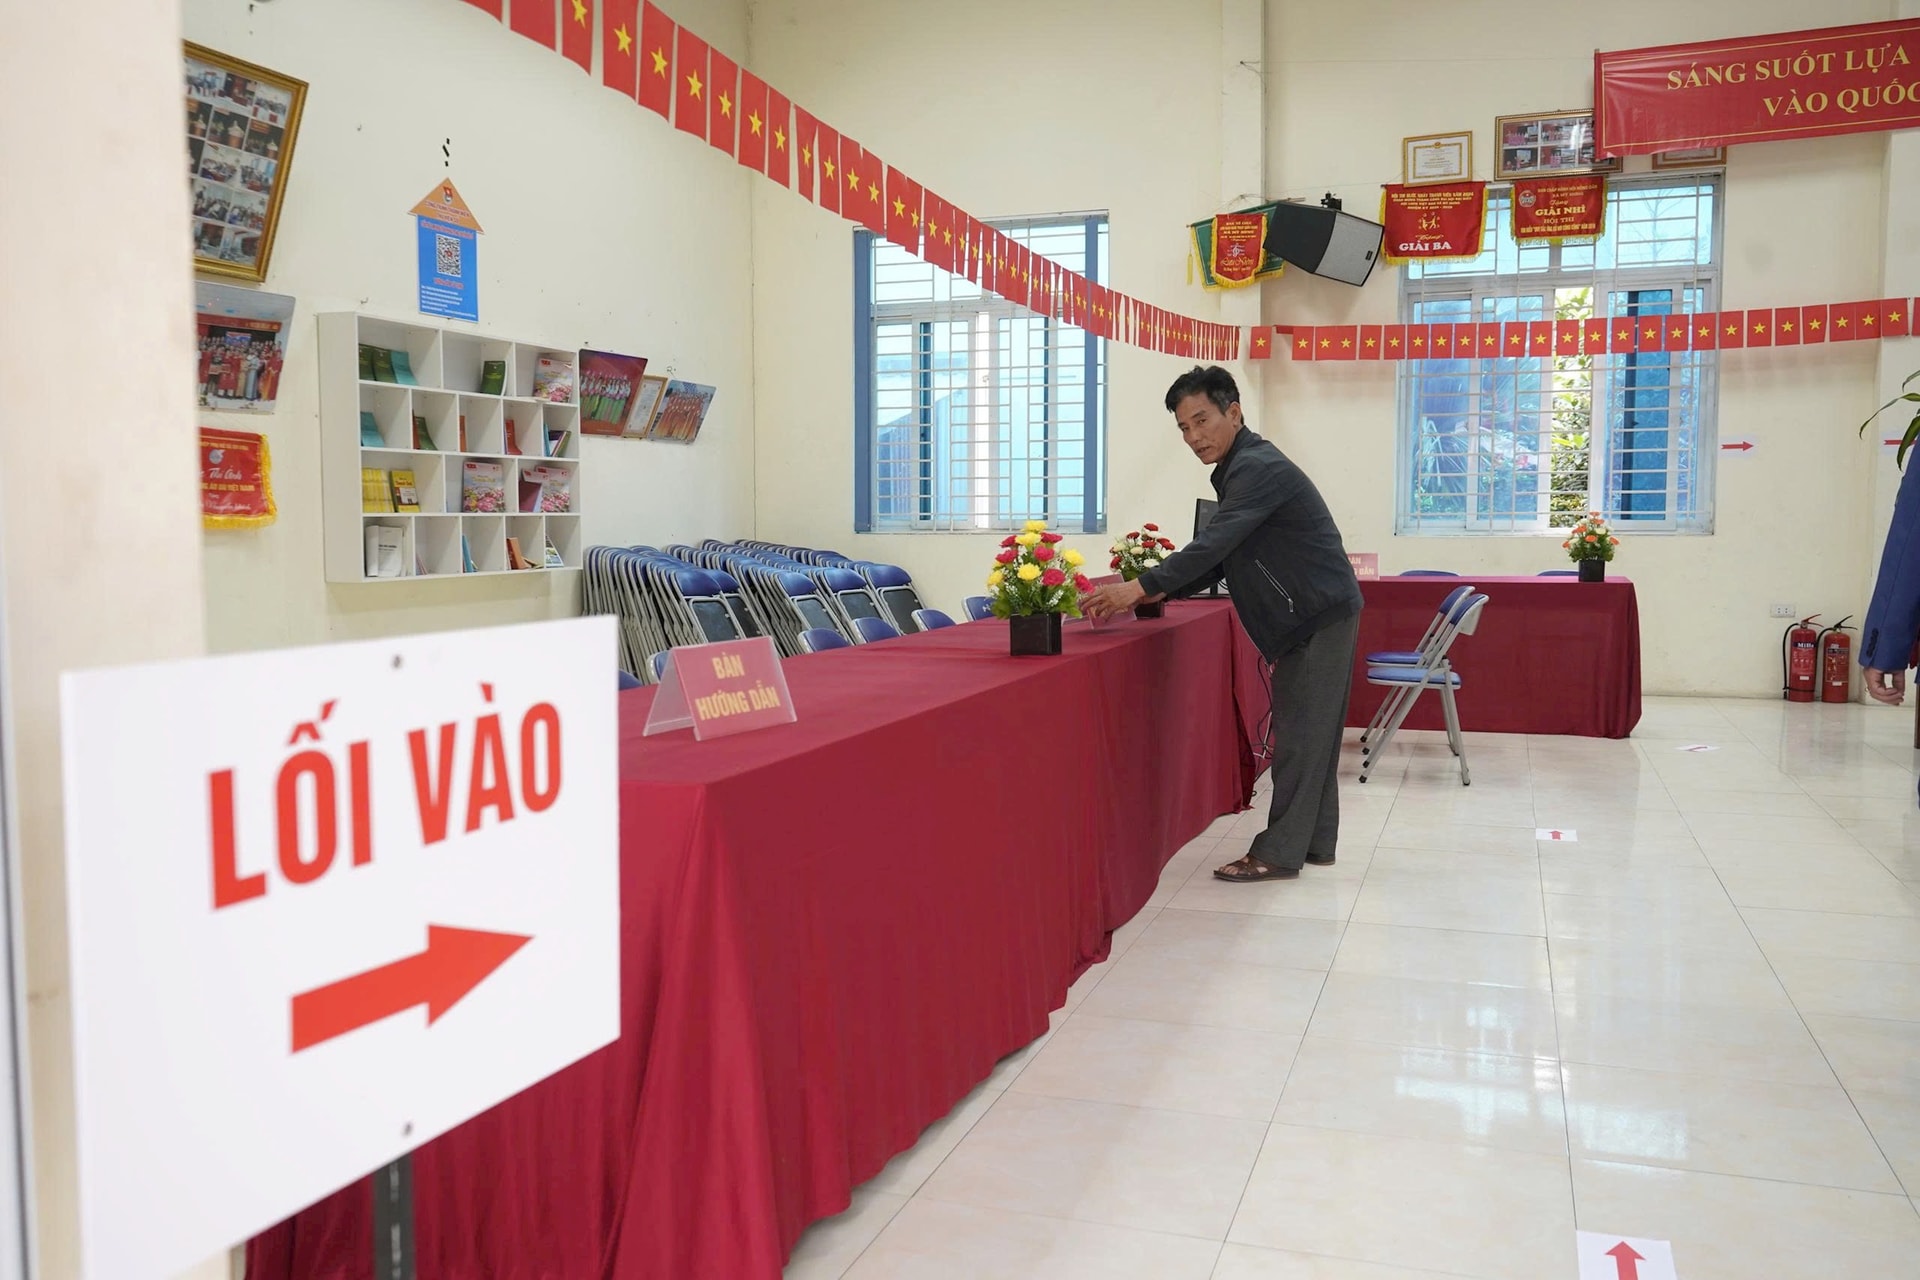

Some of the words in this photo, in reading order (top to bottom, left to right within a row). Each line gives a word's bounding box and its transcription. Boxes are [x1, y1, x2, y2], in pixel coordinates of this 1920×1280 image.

[1667, 61, 1747, 90] SÁNG
[1755, 49, 1836, 81] SUỐT
[1844, 43, 1911, 74] LỰA
[1763, 89, 1829, 117] VÀO
[1837, 77, 1920, 114] QUỐC
[1535, 206, 1562, 216] GIẢI
[1543, 217, 1558, 225] HỘI
[1399, 240, 1430, 251] GIẢI
[1433, 241, 1452, 250] BA
[711, 651, 745, 679] BÀN
[694, 690, 751, 721] HƯỚNG
[748, 680, 781, 711] DẪN
[208, 699, 372, 908] LỐI
[407, 682, 561, 845] VÀO
